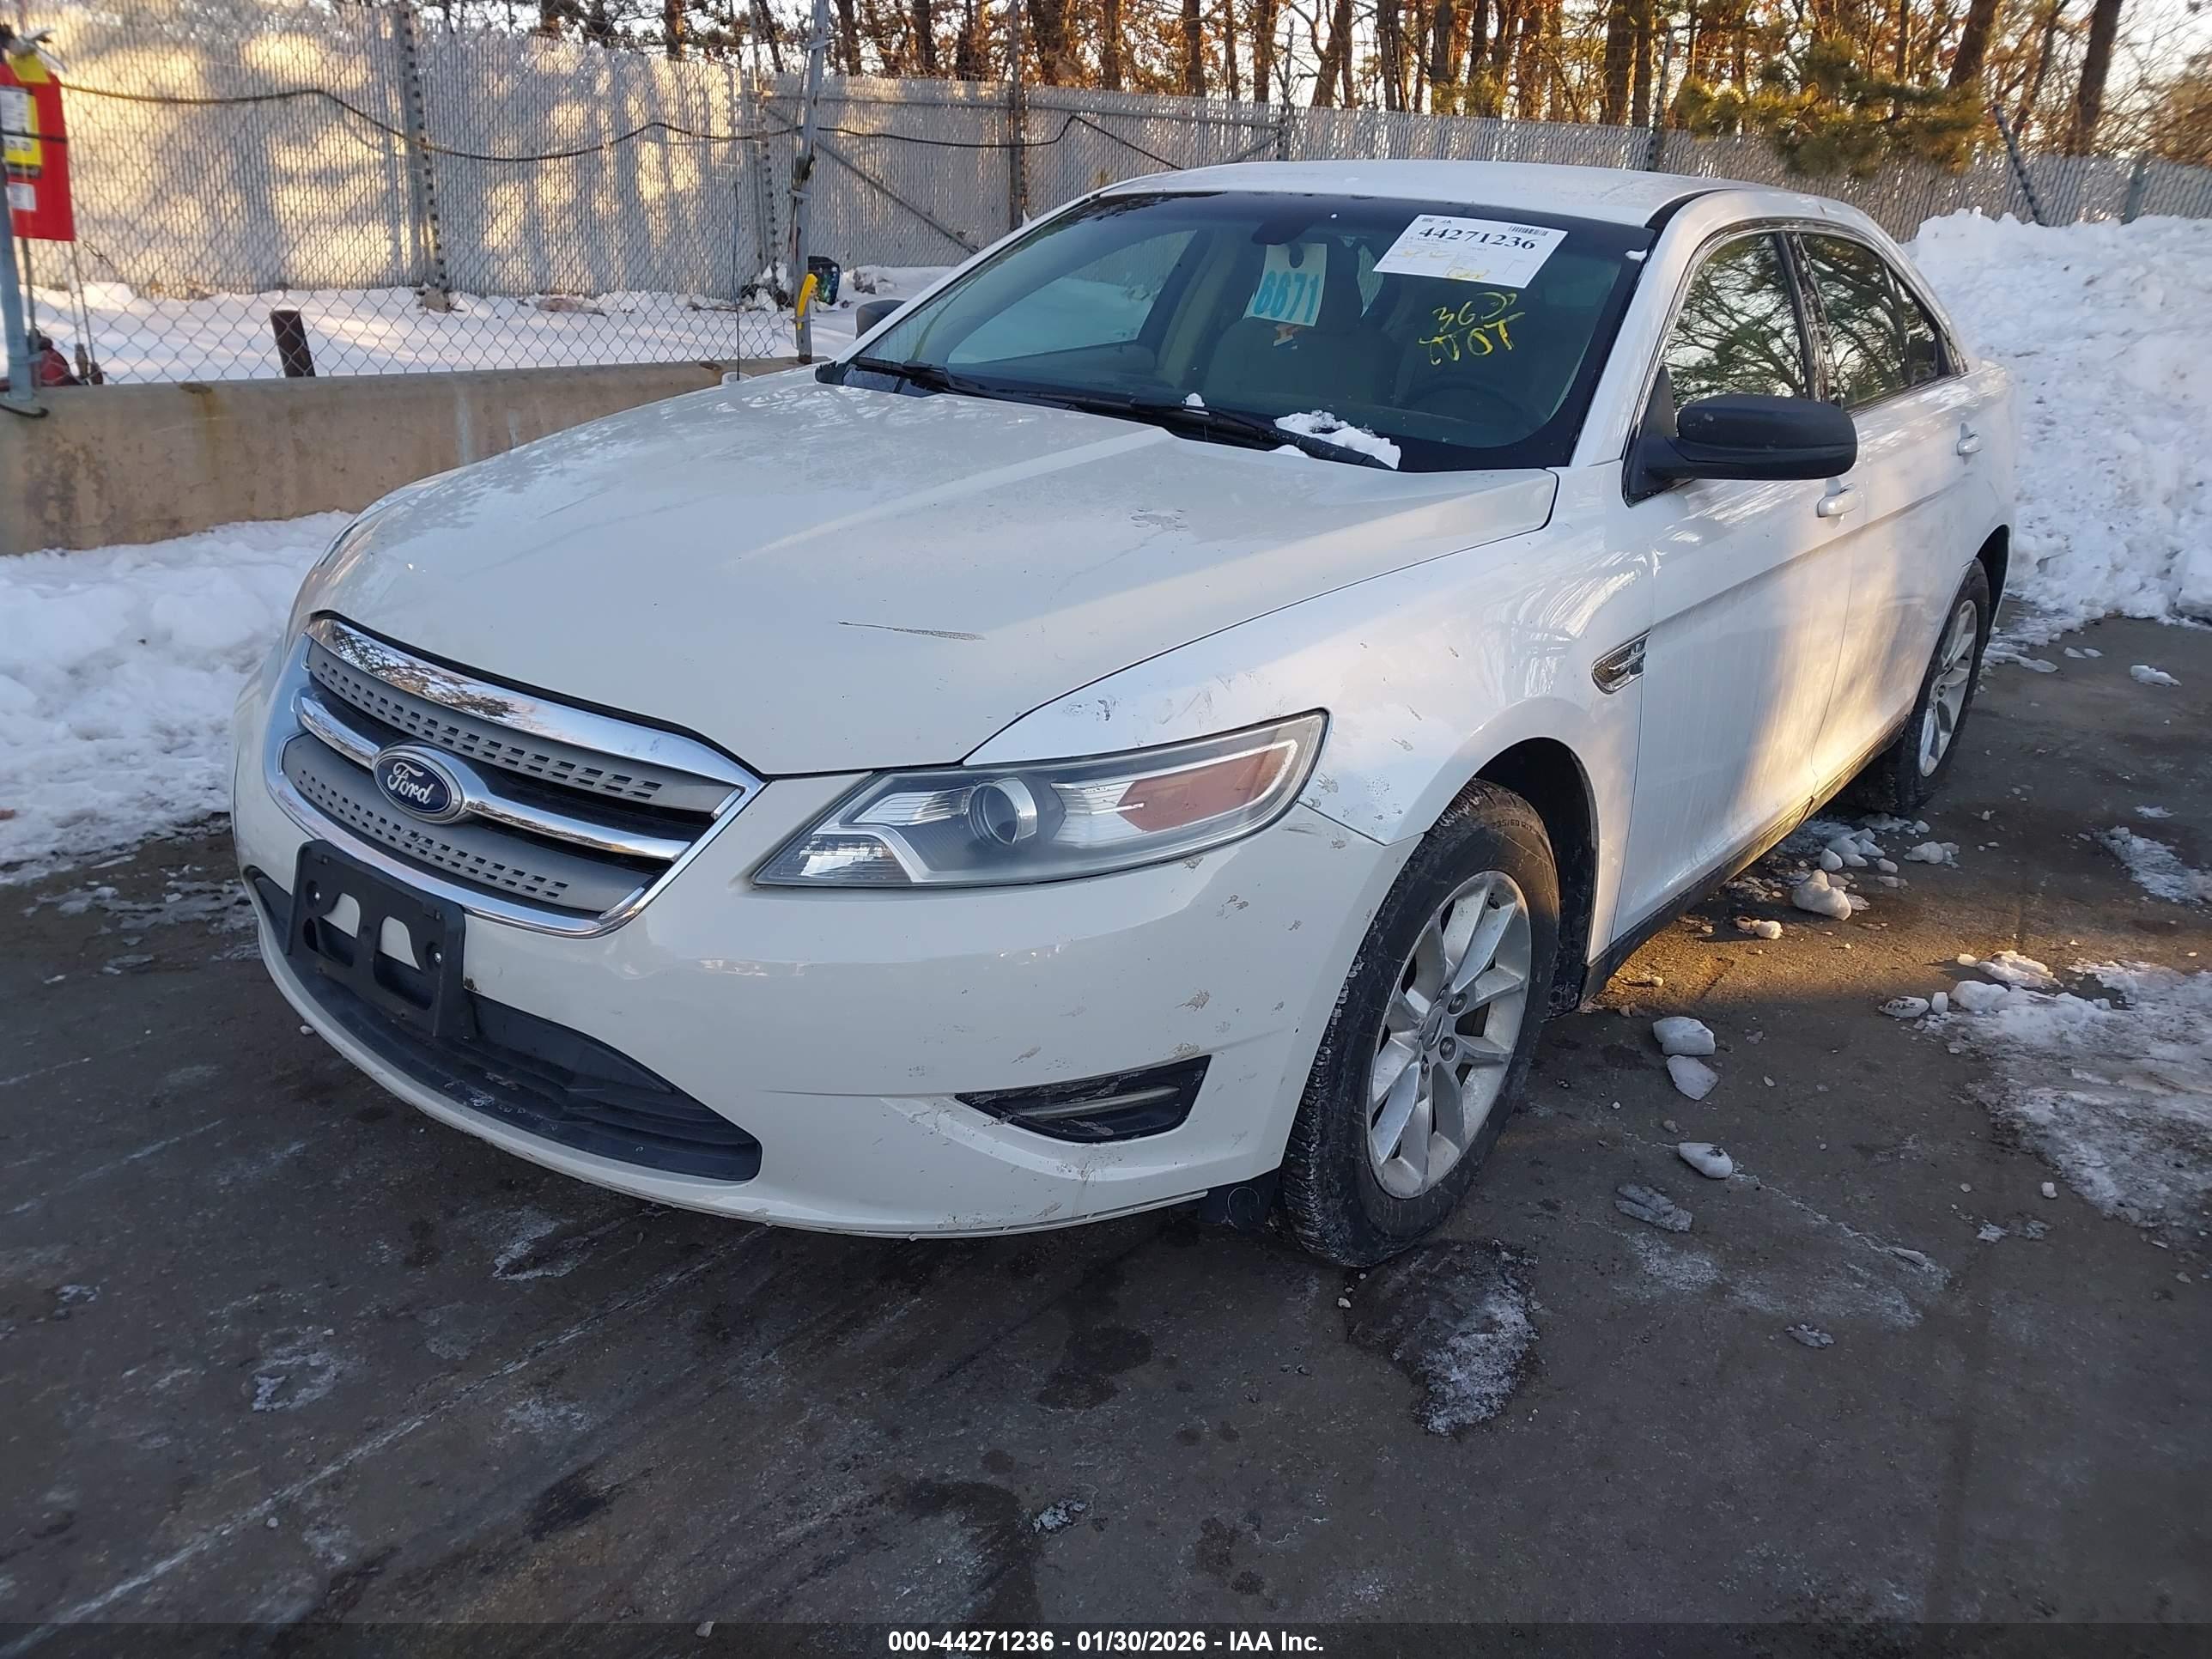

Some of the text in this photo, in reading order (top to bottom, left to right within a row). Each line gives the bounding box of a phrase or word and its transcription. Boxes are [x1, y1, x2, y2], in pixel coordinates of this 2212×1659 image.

[1419, 227, 1538, 250] 44271236
[1253, 270, 1320, 323] 6671
[387, 762, 434, 805] Ford
